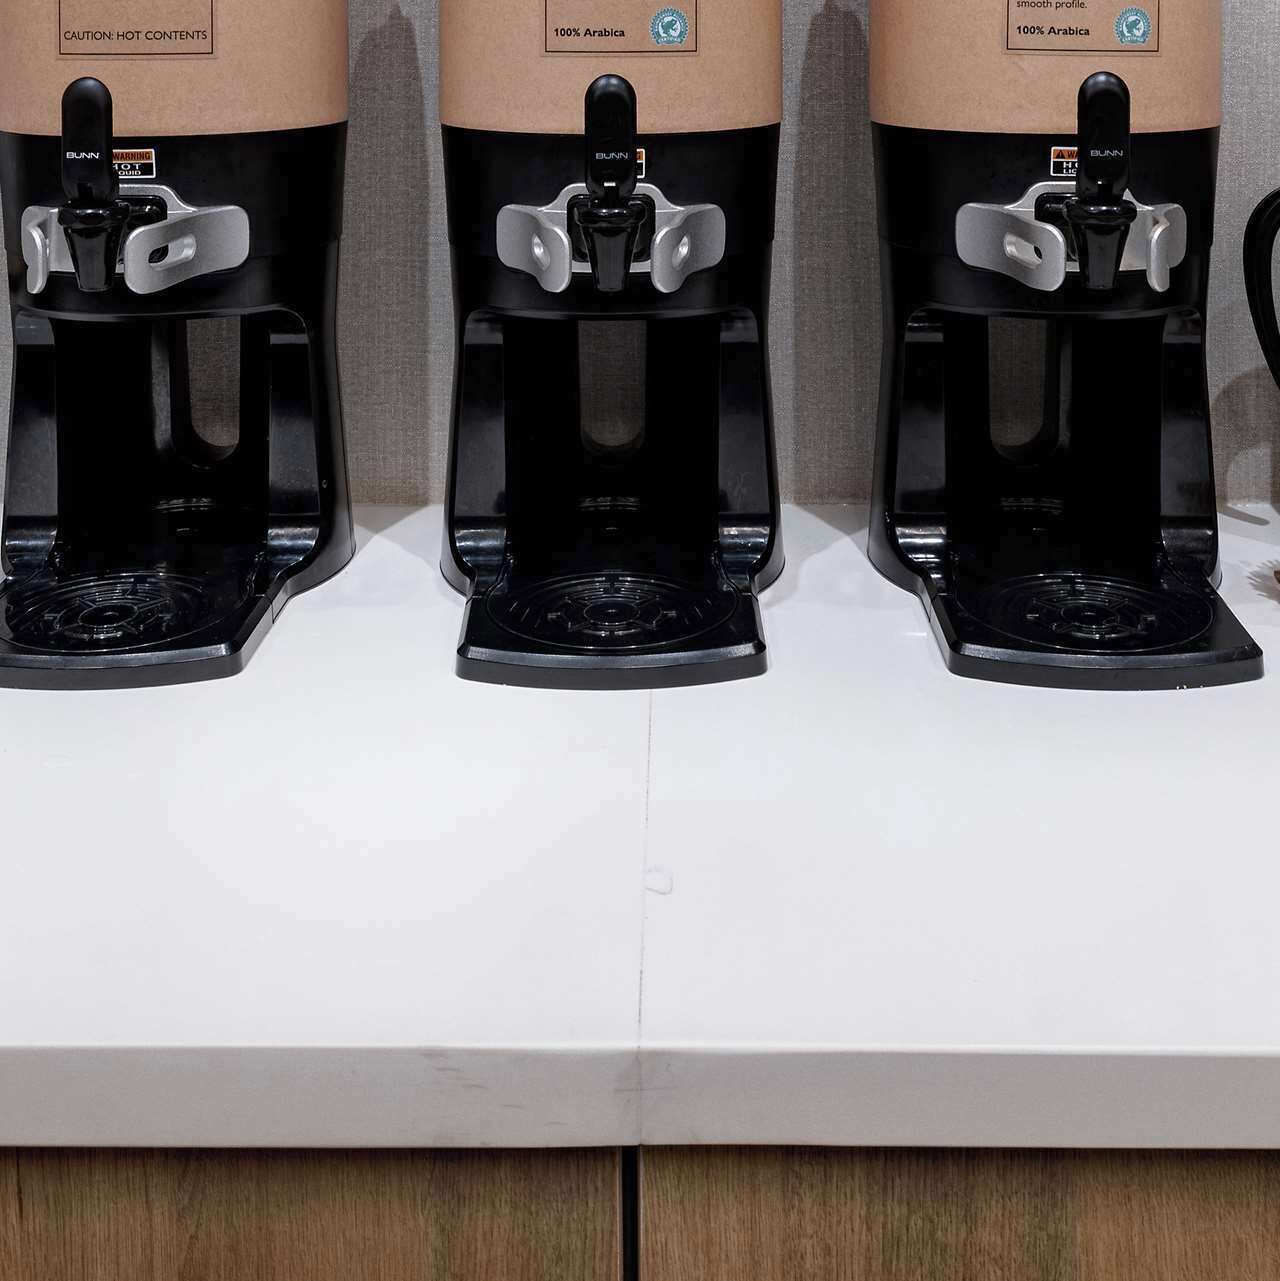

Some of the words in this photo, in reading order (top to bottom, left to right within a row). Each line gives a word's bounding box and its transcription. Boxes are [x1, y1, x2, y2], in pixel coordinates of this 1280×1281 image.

[1016, 0, 1052, 9] smooth
[1055, 0, 1088, 10] profile.
[64, 30, 114, 41] CAUTION:
[116, 30, 142, 40] HOT
[145, 30, 208, 40] CONTENTS
[554, 28, 581, 37] 100%
[584, 28, 625, 37] Arabica
[1017, 26, 1044, 35] 100%
[1048, 26, 1090, 36] Arabica
[112, 152, 151, 160] WARNING
